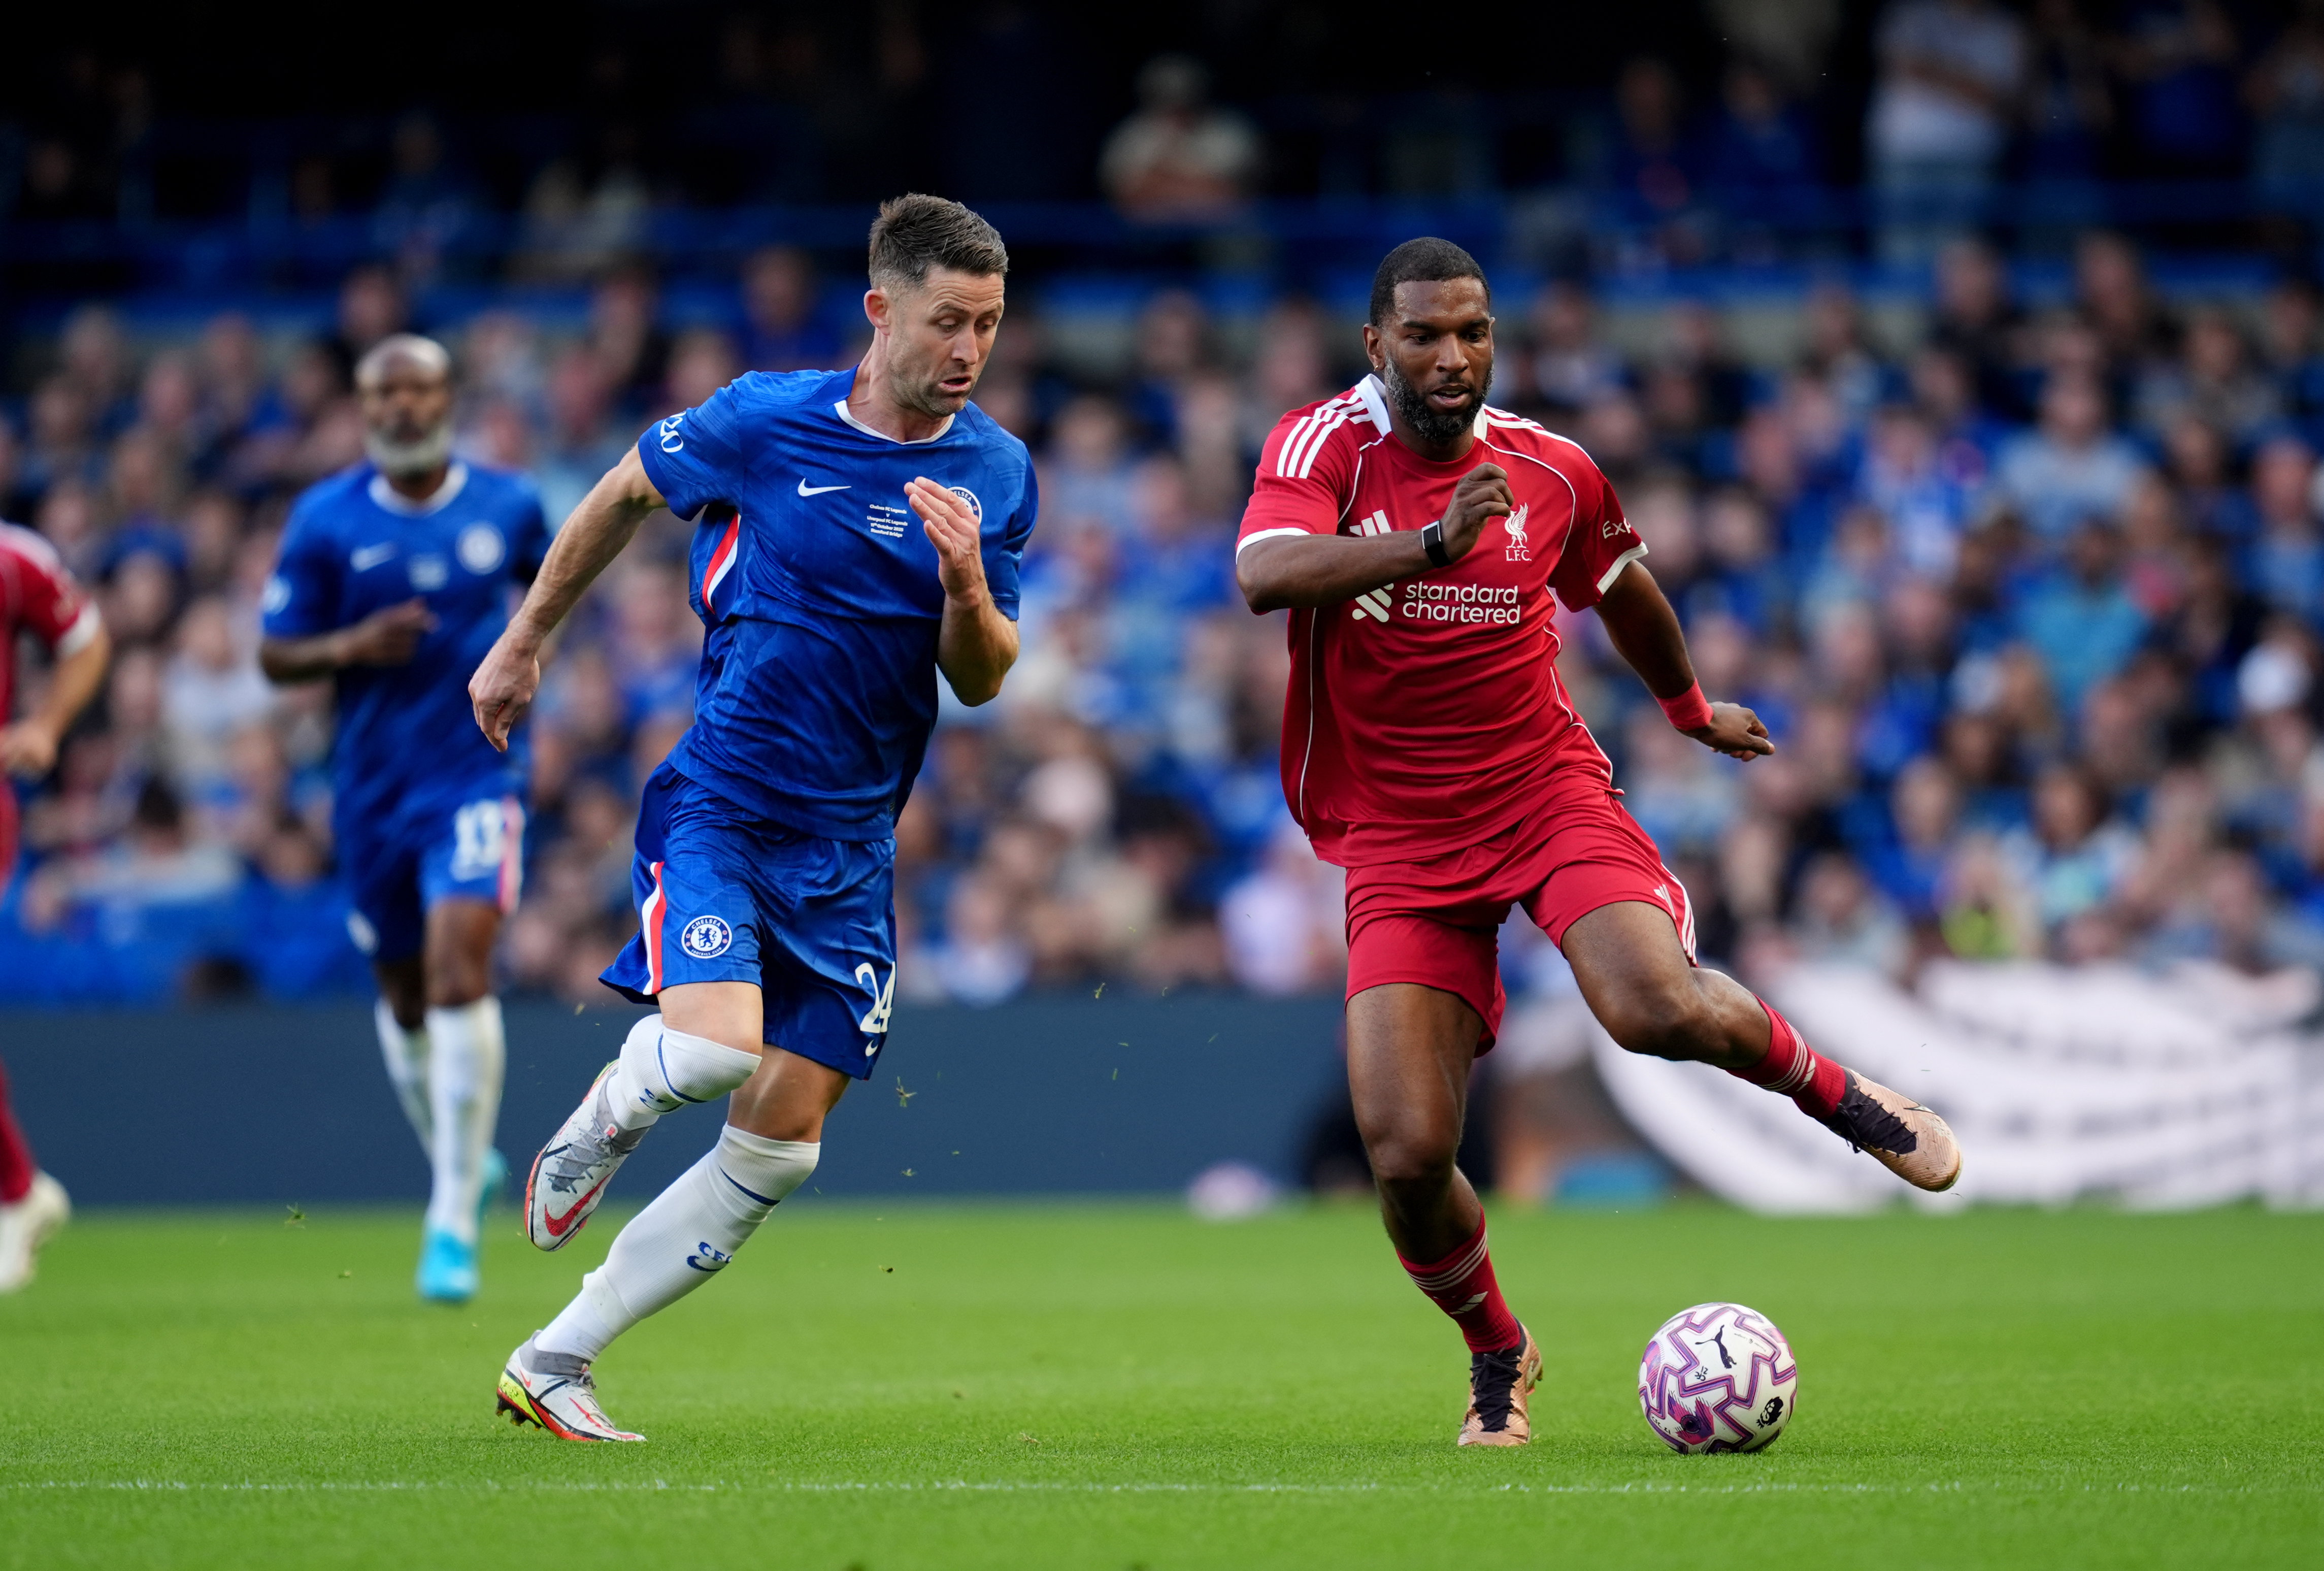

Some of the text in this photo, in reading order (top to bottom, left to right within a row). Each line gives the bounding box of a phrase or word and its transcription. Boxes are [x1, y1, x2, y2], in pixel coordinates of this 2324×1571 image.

[1505, 549, 1533, 561] L.F.C.
[1405, 581, 1518, 604] standard
[1403, 599, 1521, 624] chartered
[691, 919, 721, 930] CHELSEA
[855, 961, 896, 1034] 24
